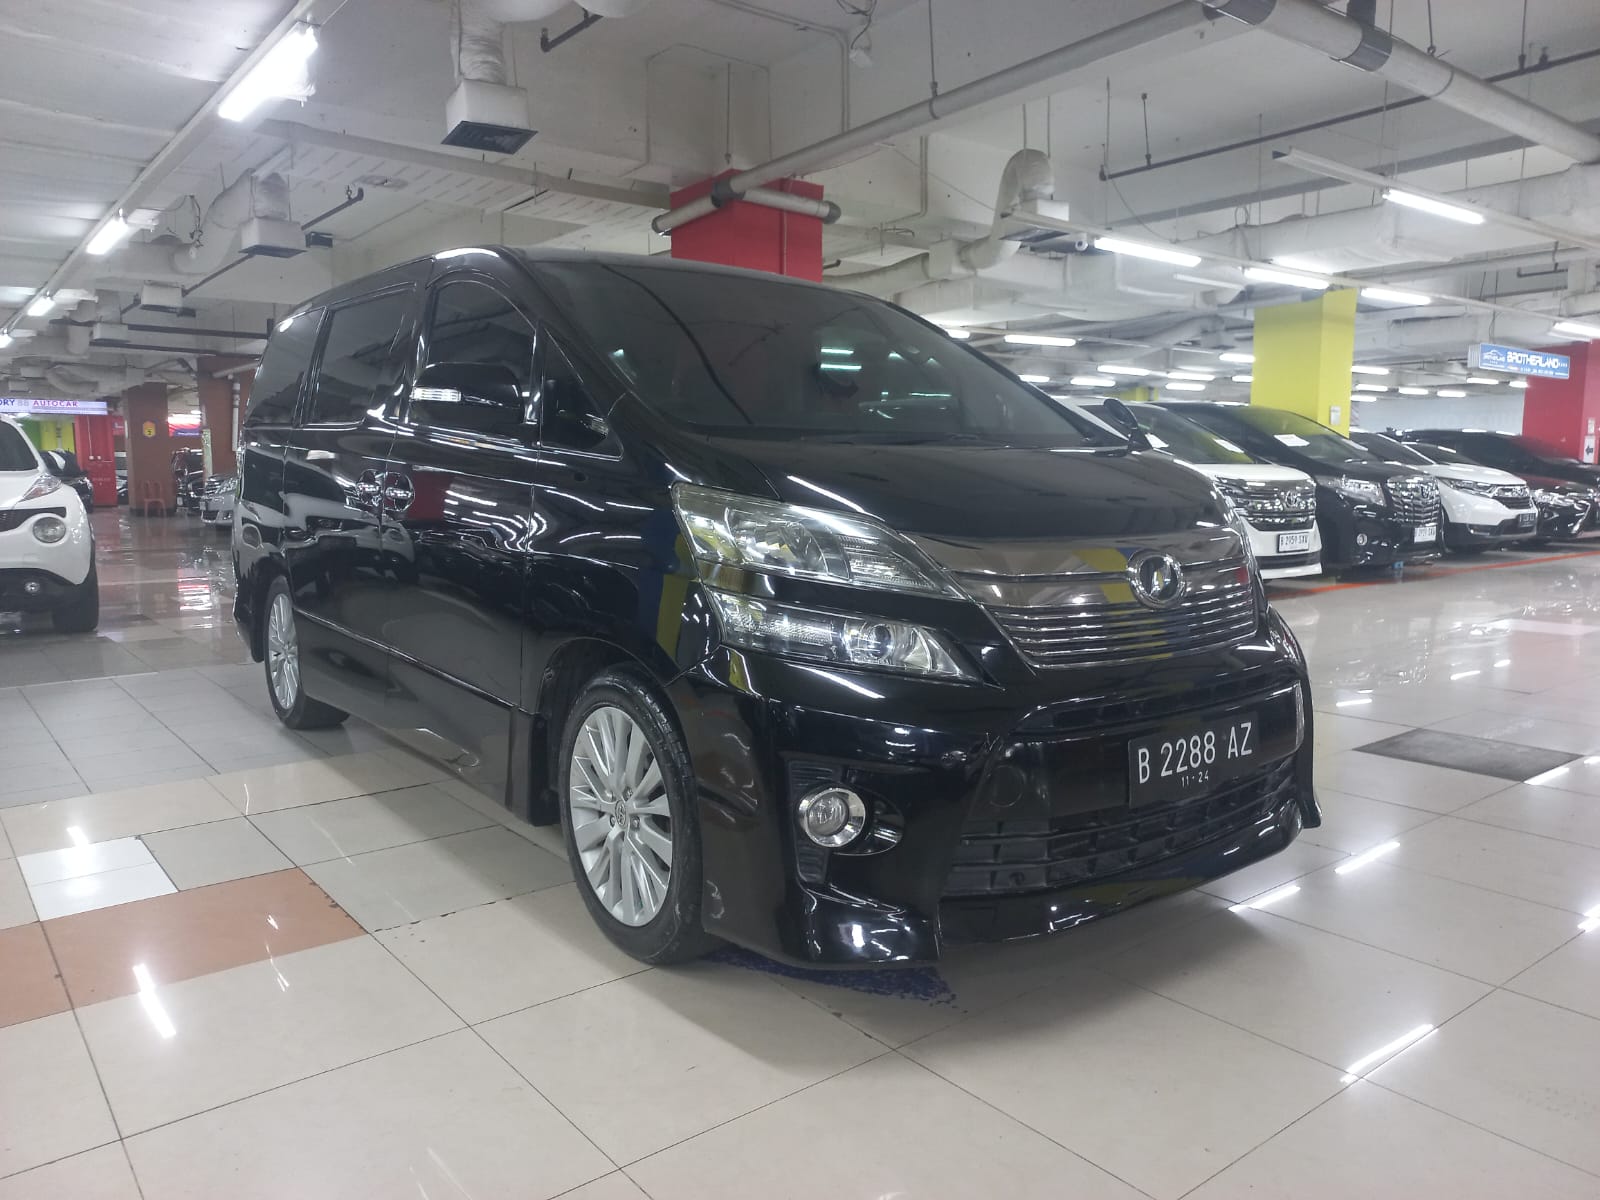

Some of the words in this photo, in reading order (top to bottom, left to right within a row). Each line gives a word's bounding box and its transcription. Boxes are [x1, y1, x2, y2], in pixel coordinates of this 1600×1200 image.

[33, 399, 78, 407] AUTOCAR
[1138, 747, 1150, 784] B
[1160, 730, 1216, 777] 2288
[1228, 721, 1253, 760] AZ
